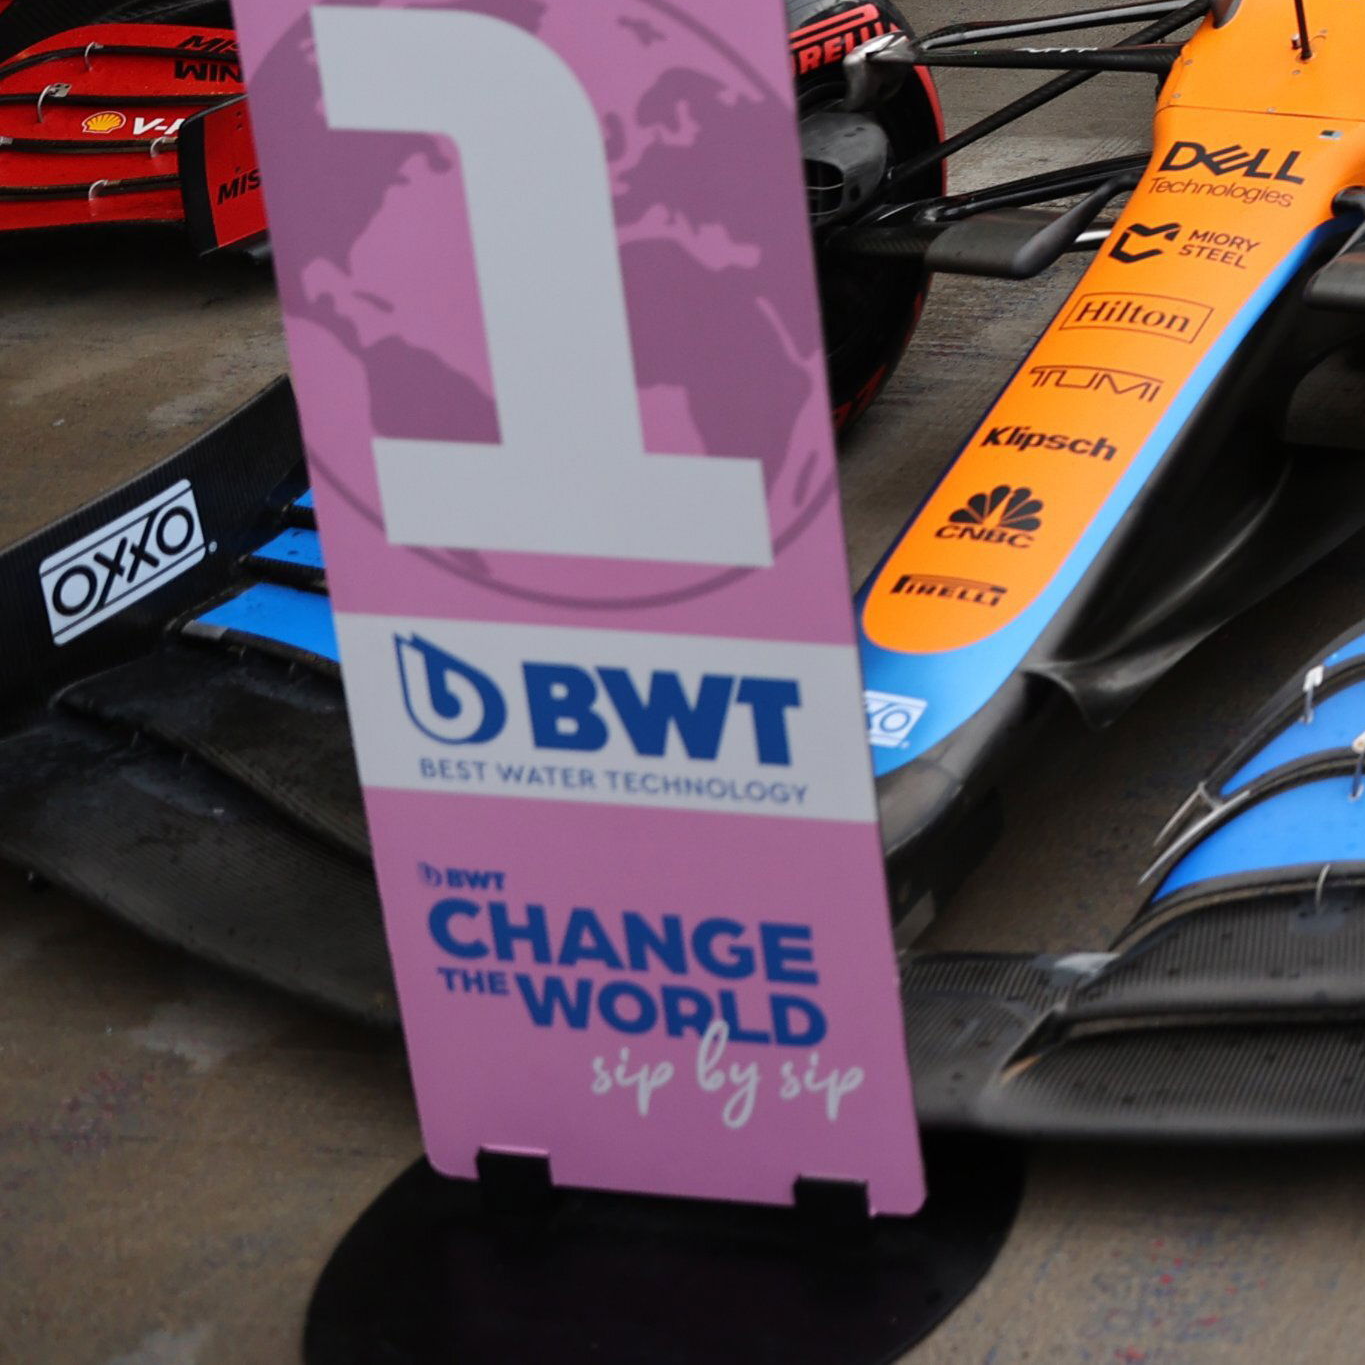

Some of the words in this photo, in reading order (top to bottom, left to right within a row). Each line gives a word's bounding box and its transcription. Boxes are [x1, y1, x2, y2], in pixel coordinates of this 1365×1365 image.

[1158, 141, 1305, 185] DELL
[1147, 176, 1294, 208] Technologies
[1178, 243, 1248, 269] STEEL
[1189, 229, 1260, 254] MIORY
[311, 5, 776, 568] 1
[1073, 299, 1191, 337] Hilton
[1030, 365, 1165, 404] TUMI
[981, 426, 1118, 462] Klipsch
[934, 524, 1035, 550] CNBC
[52, 506, 195, 616] OXXO
[890, 574, 1008, 607] PIRELLI
[521, 661, 803, 767] BWT
[419, 757, 487, 783] BEST
[496, 762, 596, 791] WATER
[604, 769, 809, 807] TECHNOLOGY
[445, 866, 507, 892] BWT
[427, 897, 820, 986] CHANGE
[438, 967, 509, 997] THE
[513, 972, 828, 1048] WORLD
[590, 1047, 675, 1117] sip
[695, 1020, 760, 1129] by
[779, 1052, 866, 1122] sip
